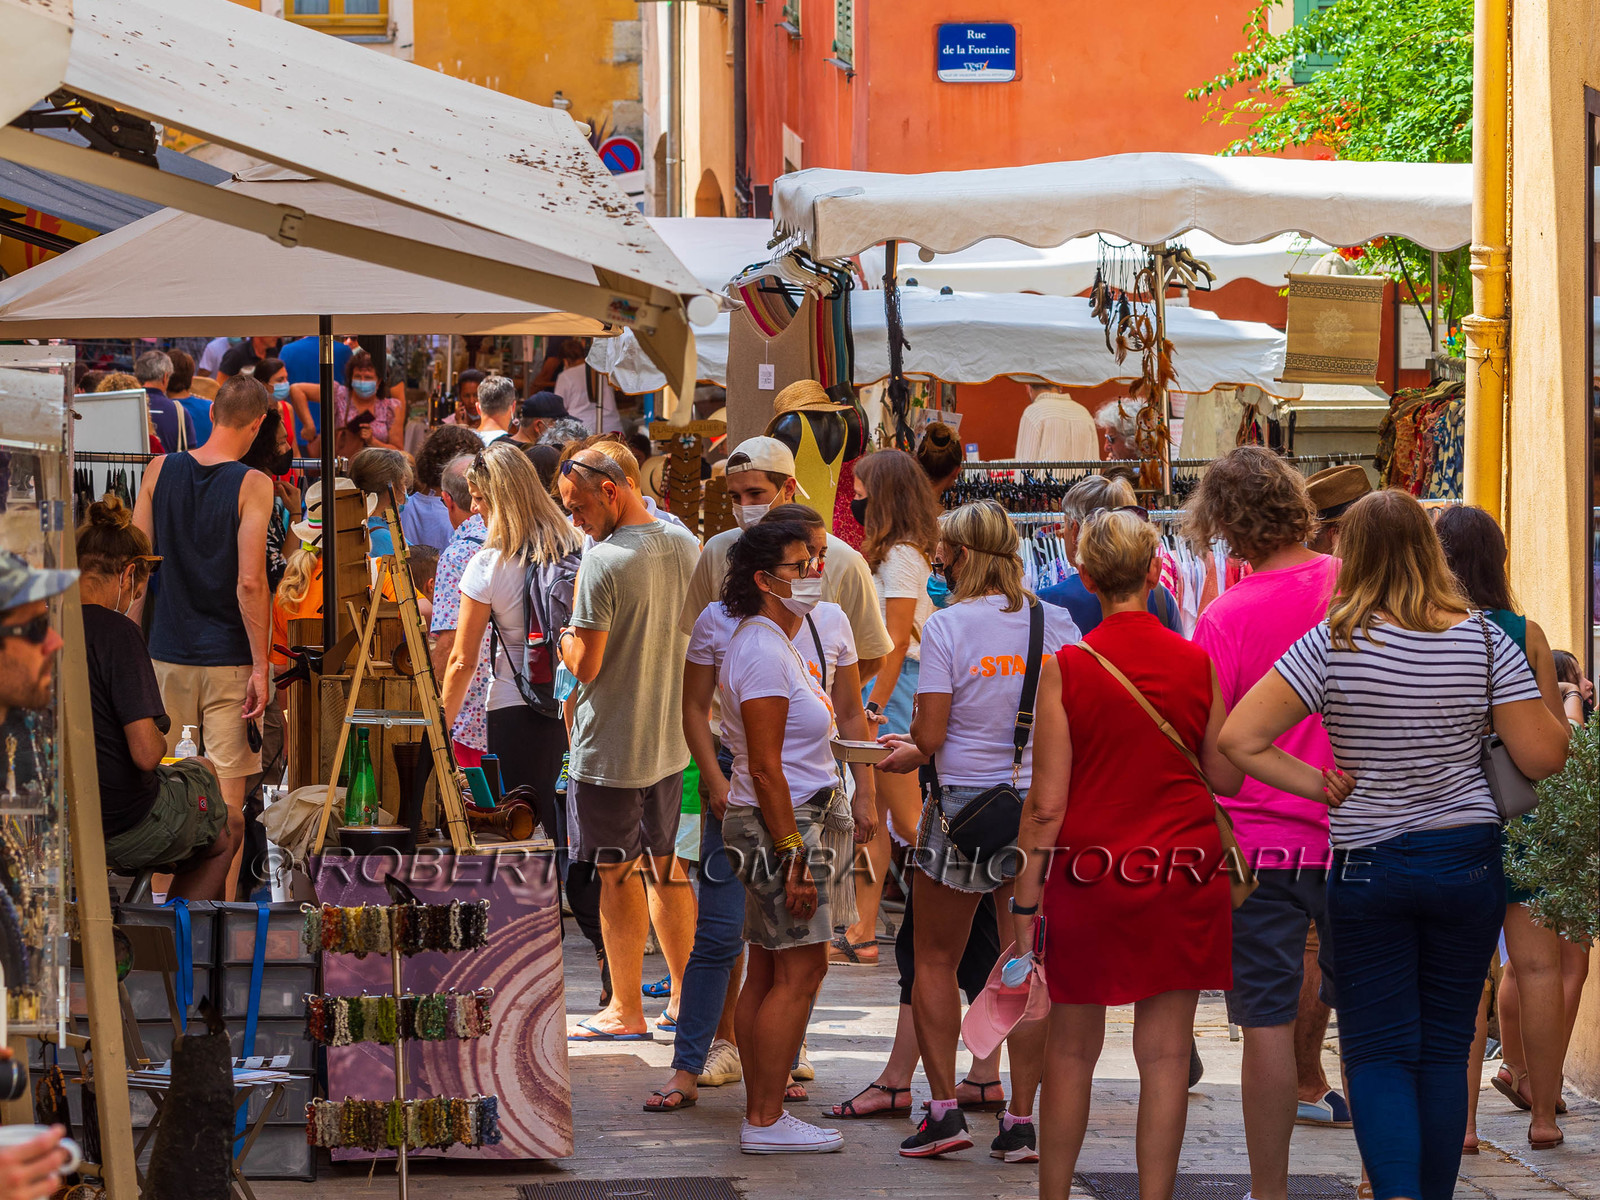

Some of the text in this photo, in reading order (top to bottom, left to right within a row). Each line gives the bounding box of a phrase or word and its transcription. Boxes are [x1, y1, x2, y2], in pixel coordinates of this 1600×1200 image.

[967, 30, 986, 39] Rue
[943, 45, 1010, 54] de la Fontaine
